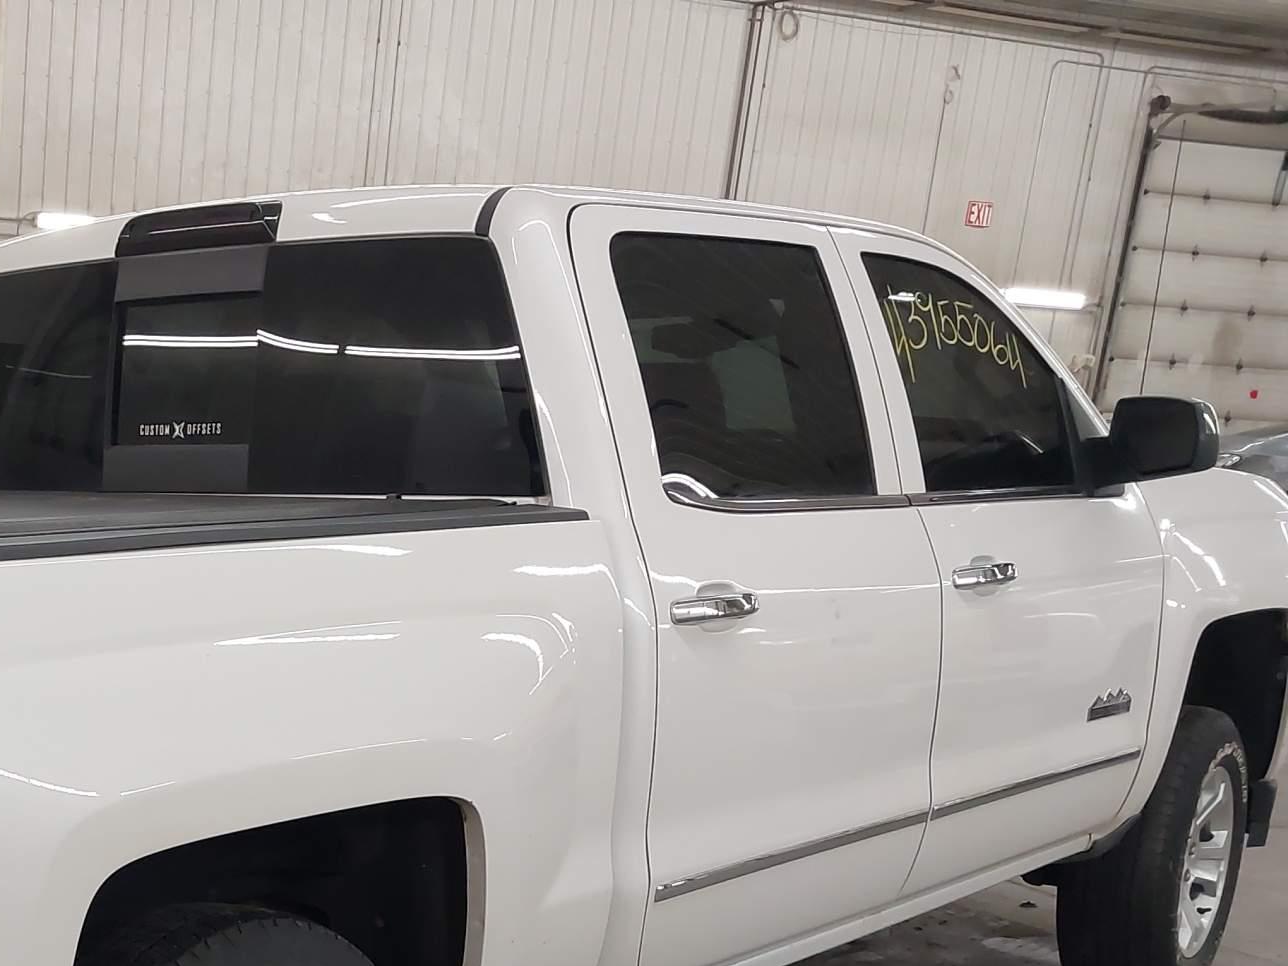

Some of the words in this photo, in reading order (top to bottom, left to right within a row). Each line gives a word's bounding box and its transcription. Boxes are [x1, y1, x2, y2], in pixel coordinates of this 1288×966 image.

[968, 203, 993, 225] EXIT
[883, 284, 1027, 389] 43955064
[139, 424, 170, 436] CUSTOM
[186, 422, 222, 435] OFFSETS
